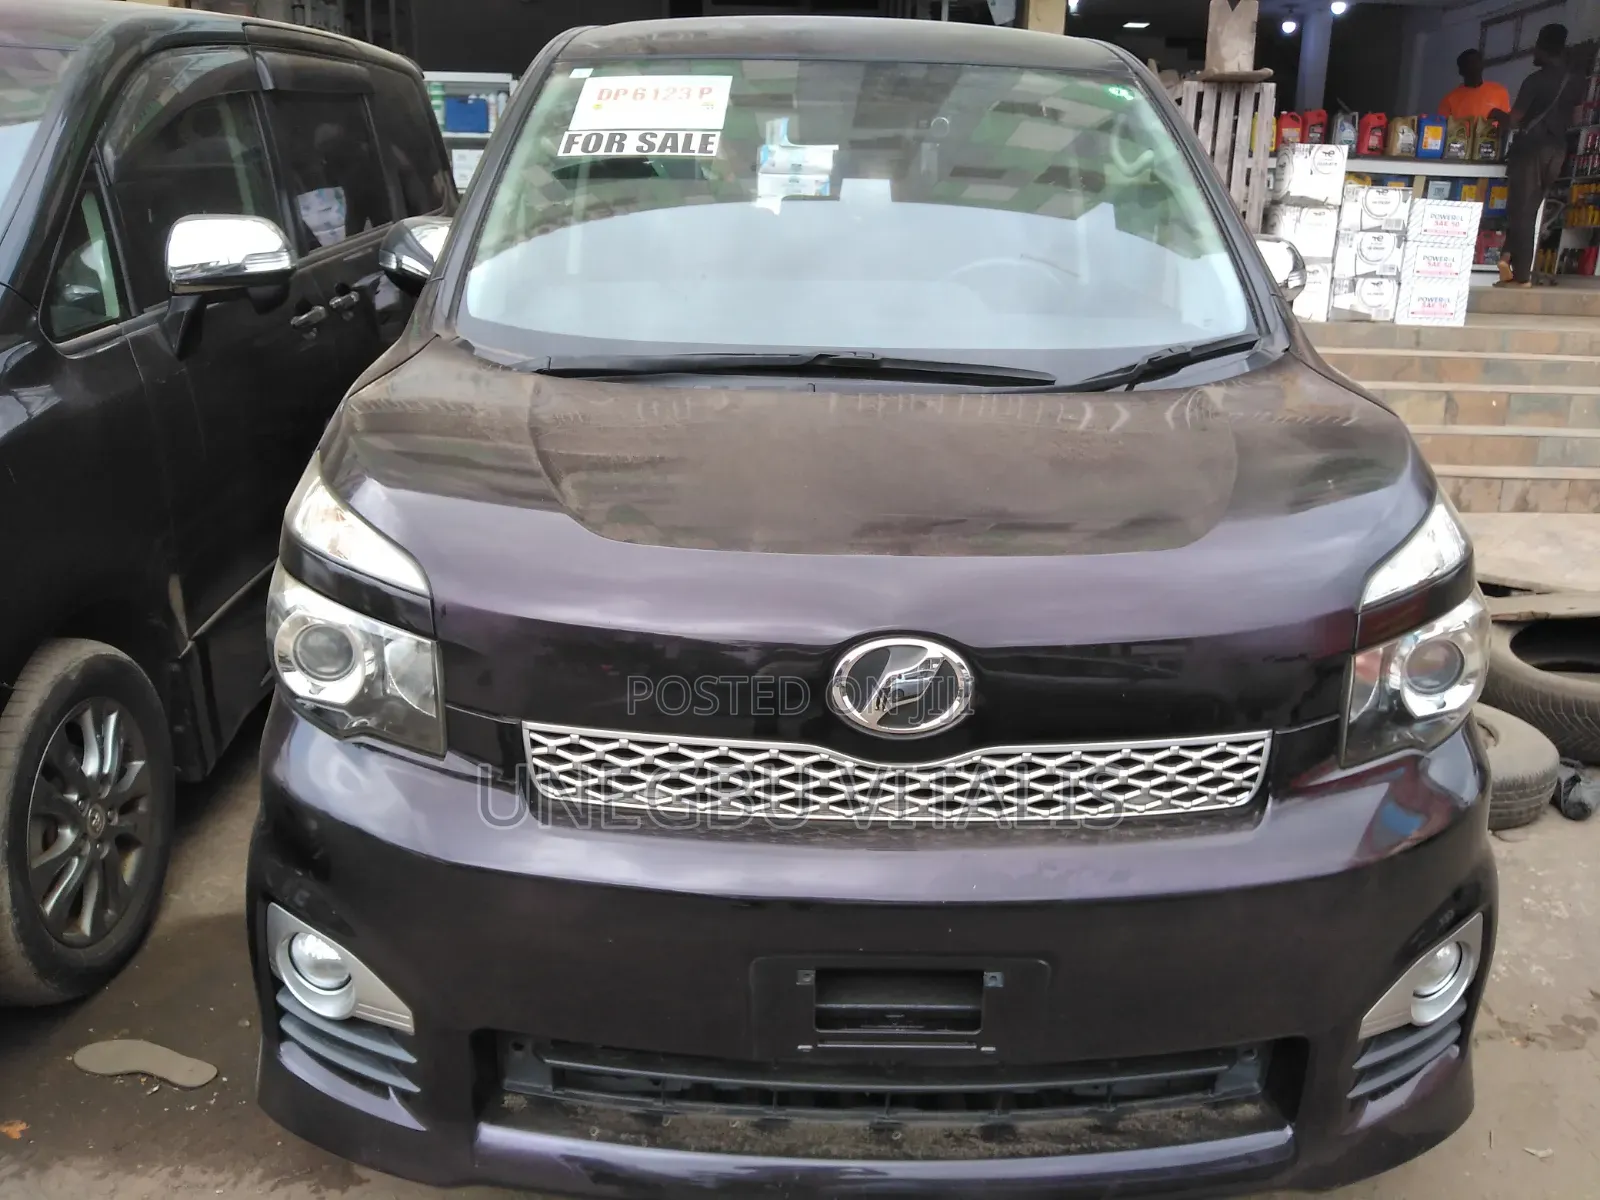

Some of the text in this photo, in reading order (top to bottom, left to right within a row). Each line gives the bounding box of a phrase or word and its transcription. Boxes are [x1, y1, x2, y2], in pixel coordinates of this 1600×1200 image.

[597, 88, 628, 101] DP
[698, 87, 713, 100] P
[562, 131, 717, 155] FOR SALE
